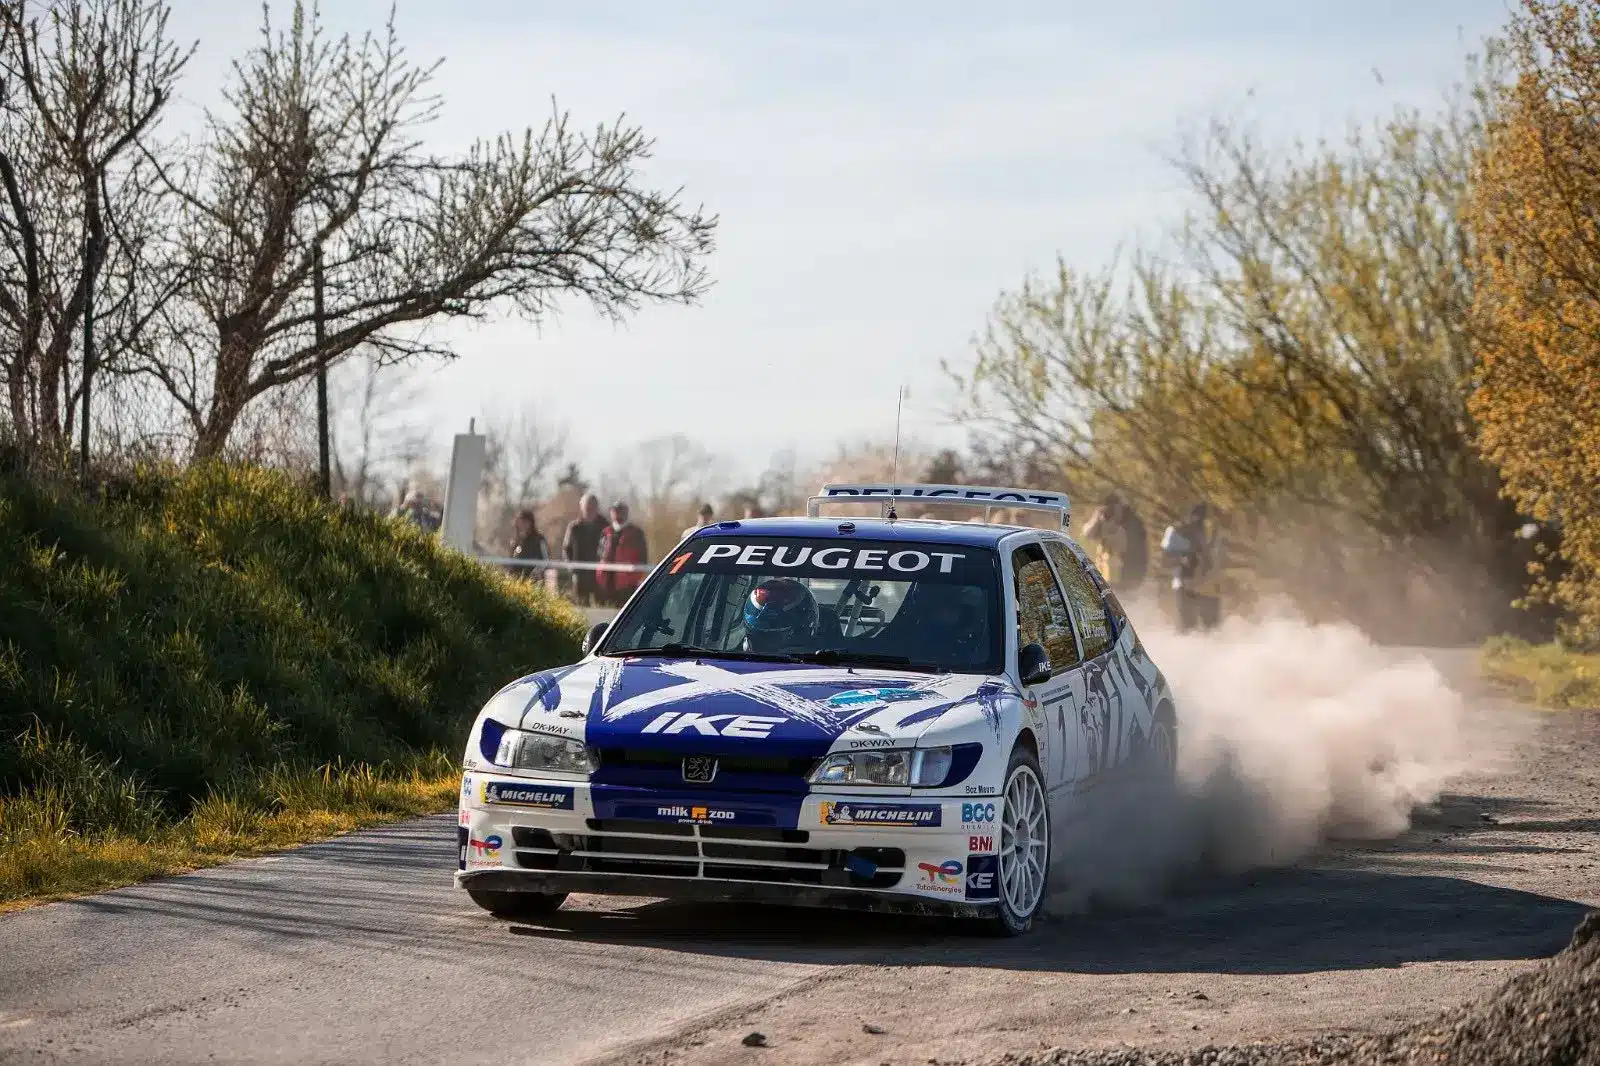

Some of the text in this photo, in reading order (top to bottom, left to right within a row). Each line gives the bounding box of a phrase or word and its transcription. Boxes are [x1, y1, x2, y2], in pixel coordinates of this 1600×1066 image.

[668, 552, 693, 575] 1
[697, 544, 966, 574] PEUGEOT
[1039, 661, 1052, 673] IKE
[641, 711, 790, 739] IKE
[850, 739, 897, 749] DK-WAY
[501, 790, 566, 803] MICHELIN
[657, 806, 736, 820] milk zoo
[855, 808, 934, 821] MICHELIN
[962, 803, 995, 822] BCC
[966, 872, 995, 889] KE
[916, 883, 963, 894] TotalEnergies
